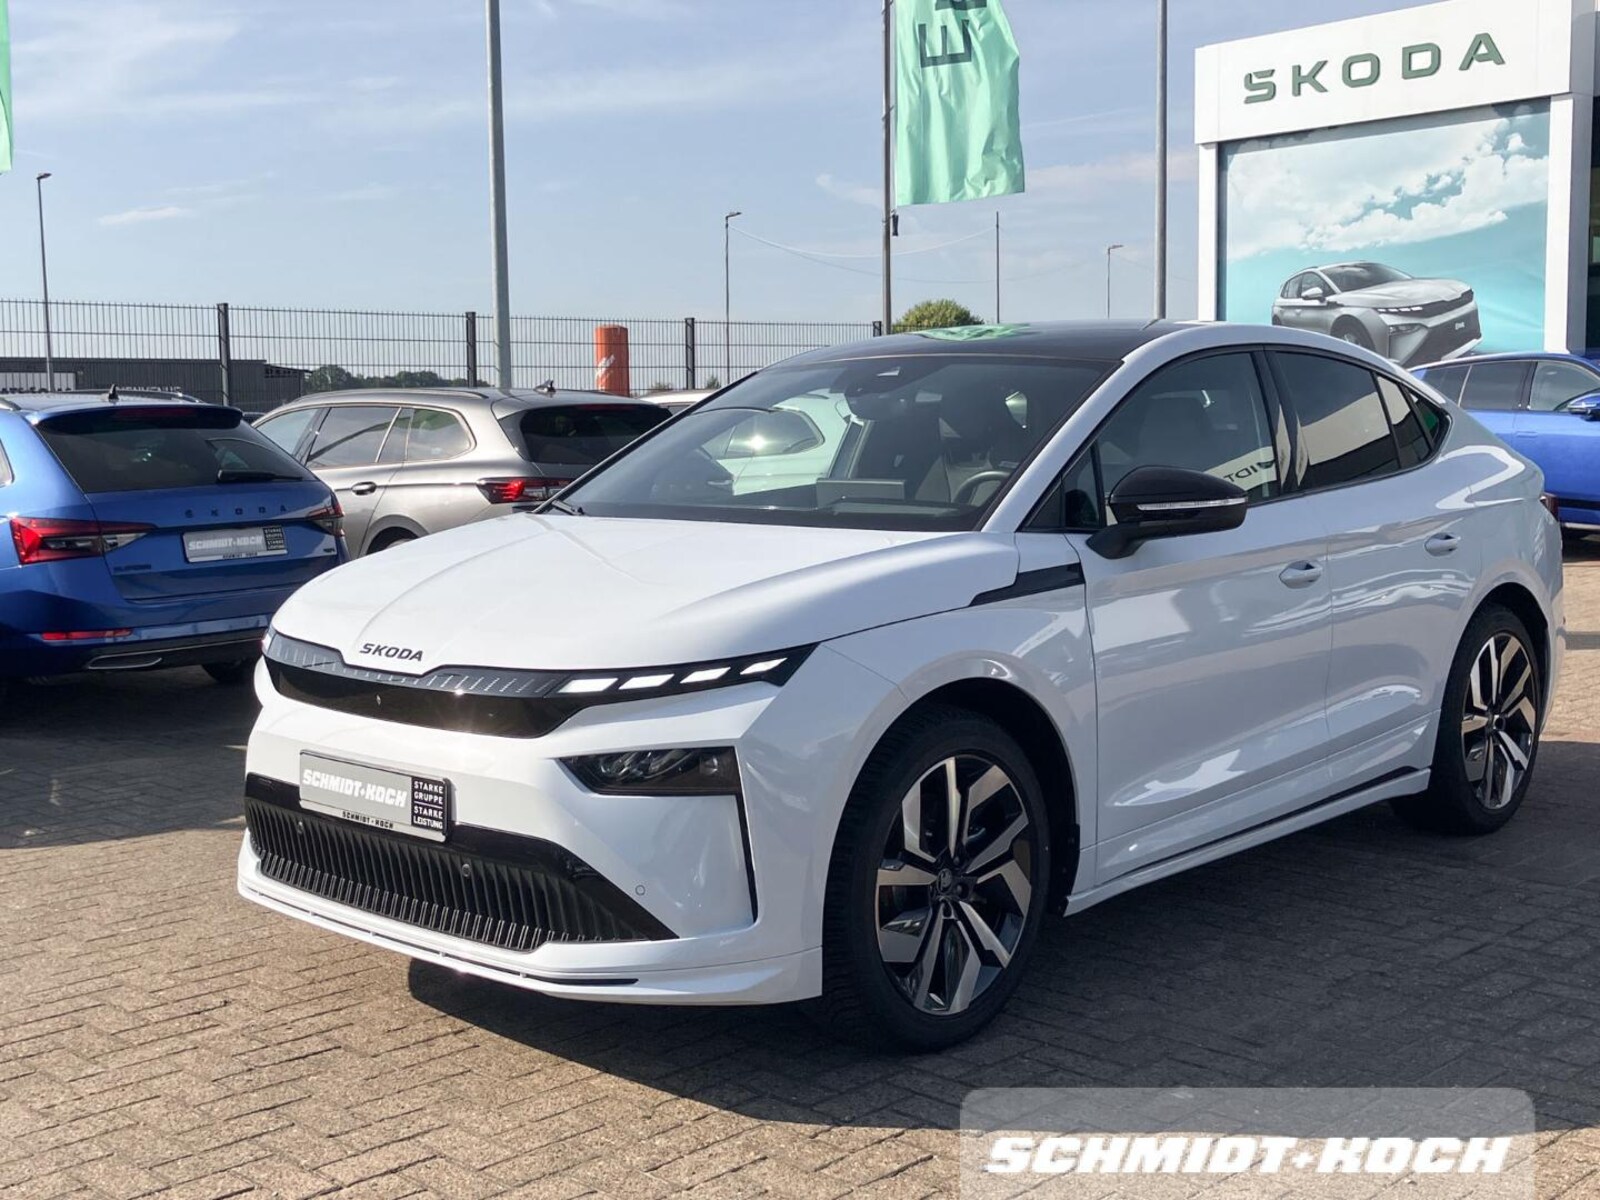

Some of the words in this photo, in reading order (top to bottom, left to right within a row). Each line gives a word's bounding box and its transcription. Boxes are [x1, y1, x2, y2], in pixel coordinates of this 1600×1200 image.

[359, 642, 424, 662] SKODA
[413, 780, 444, 794] STARKE
[413, 791, 443, 805] GRUPPE
[413, 806, 443, 819] STARKE
[413, 817, 443, 830] LEISTUNG
